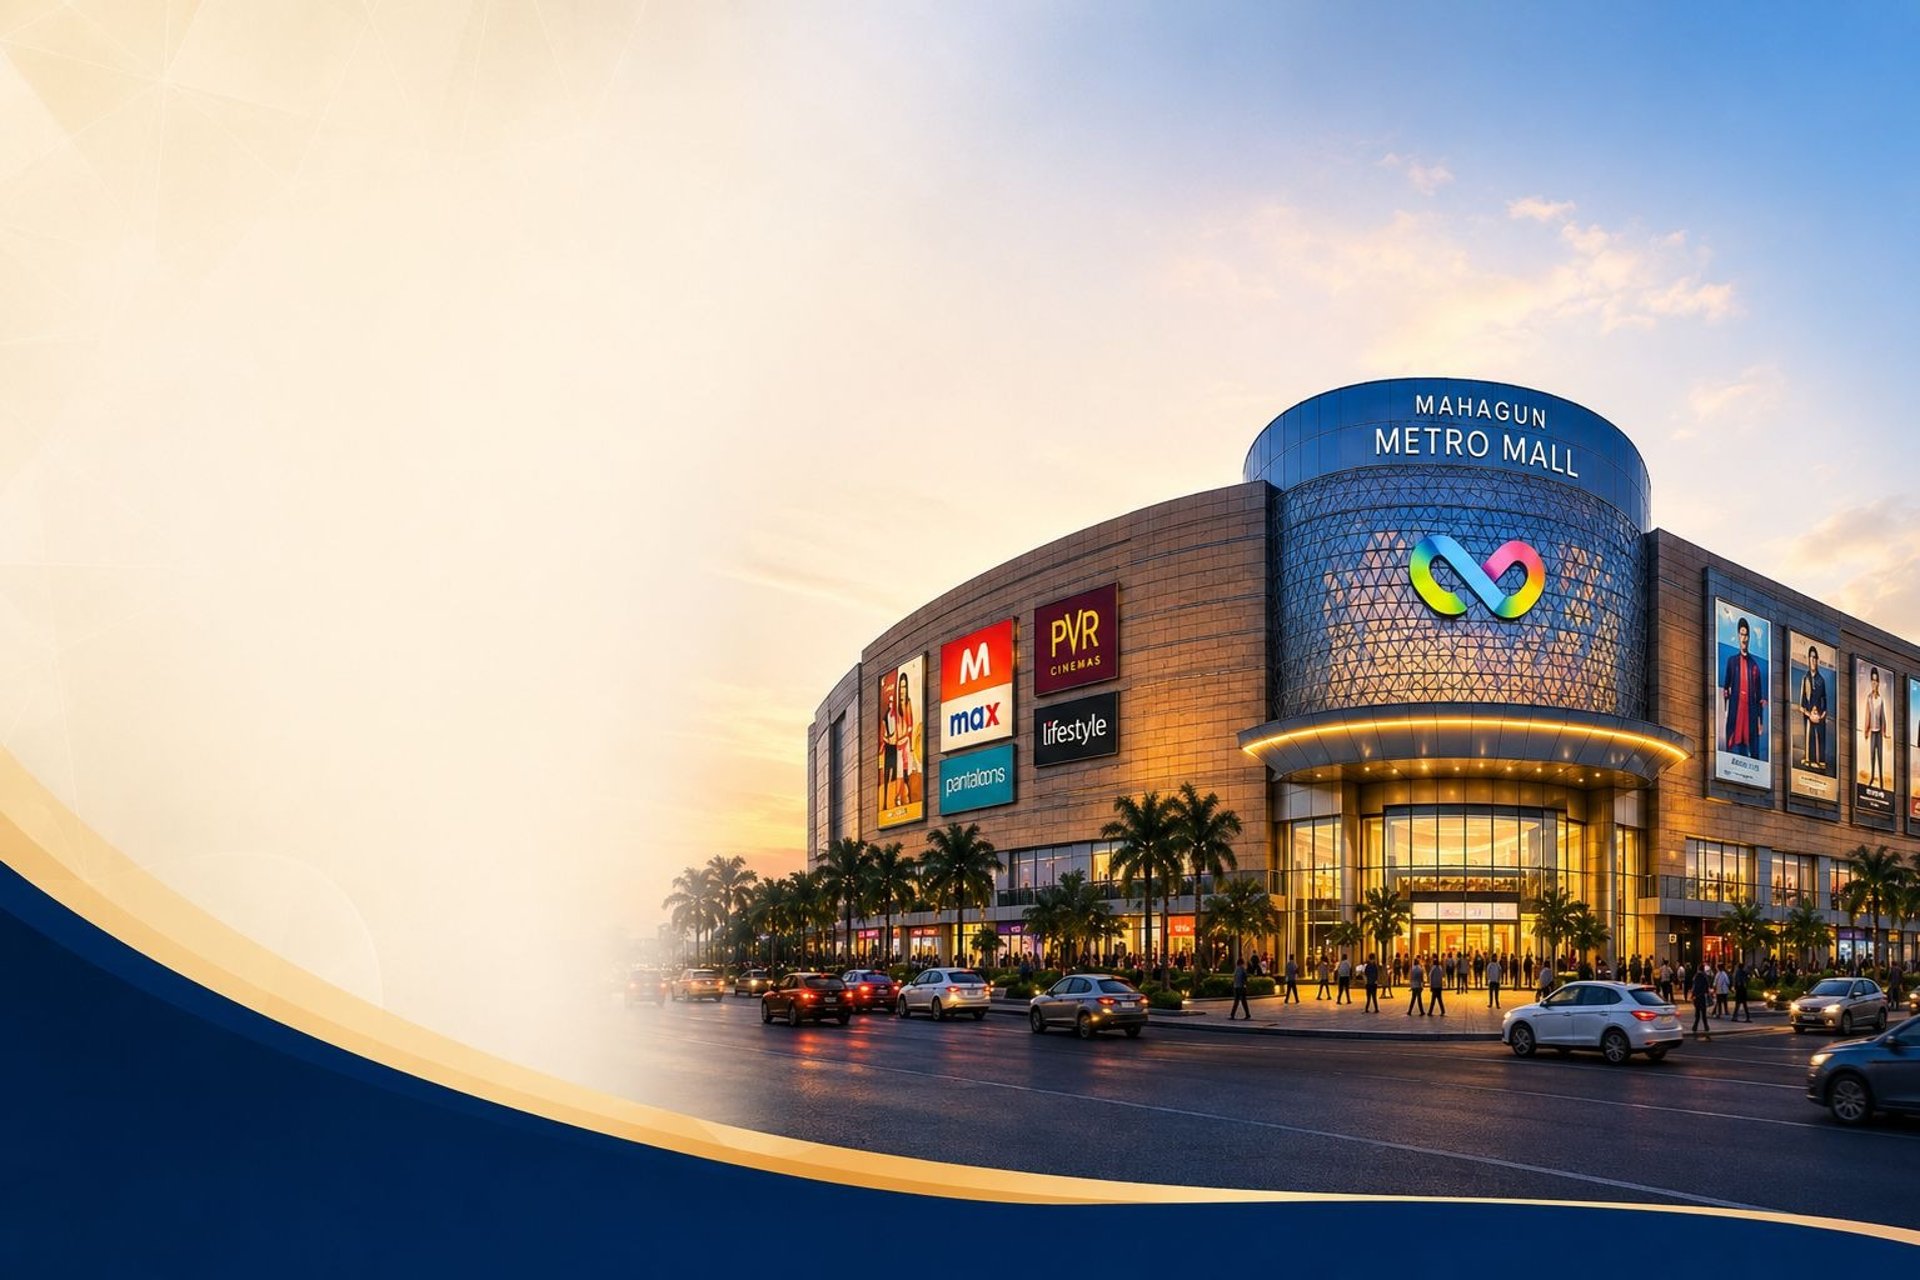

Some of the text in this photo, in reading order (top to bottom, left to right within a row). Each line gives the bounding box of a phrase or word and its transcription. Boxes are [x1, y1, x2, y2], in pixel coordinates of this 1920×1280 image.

[1416, 395, 1546, 429] MAHAGUN
[1376, 428, 1579, 478] METRO MALL
[1051, 608, 1099, 658] PVR
[960, 642, 990, 684] M
[1050, 656, 1101, 676] CINEMAS
[950, 701, 1000, 737] max
[1043, 714, 1107, 746] lifestyle
[946, 767, 1005, 796] pantaloons
